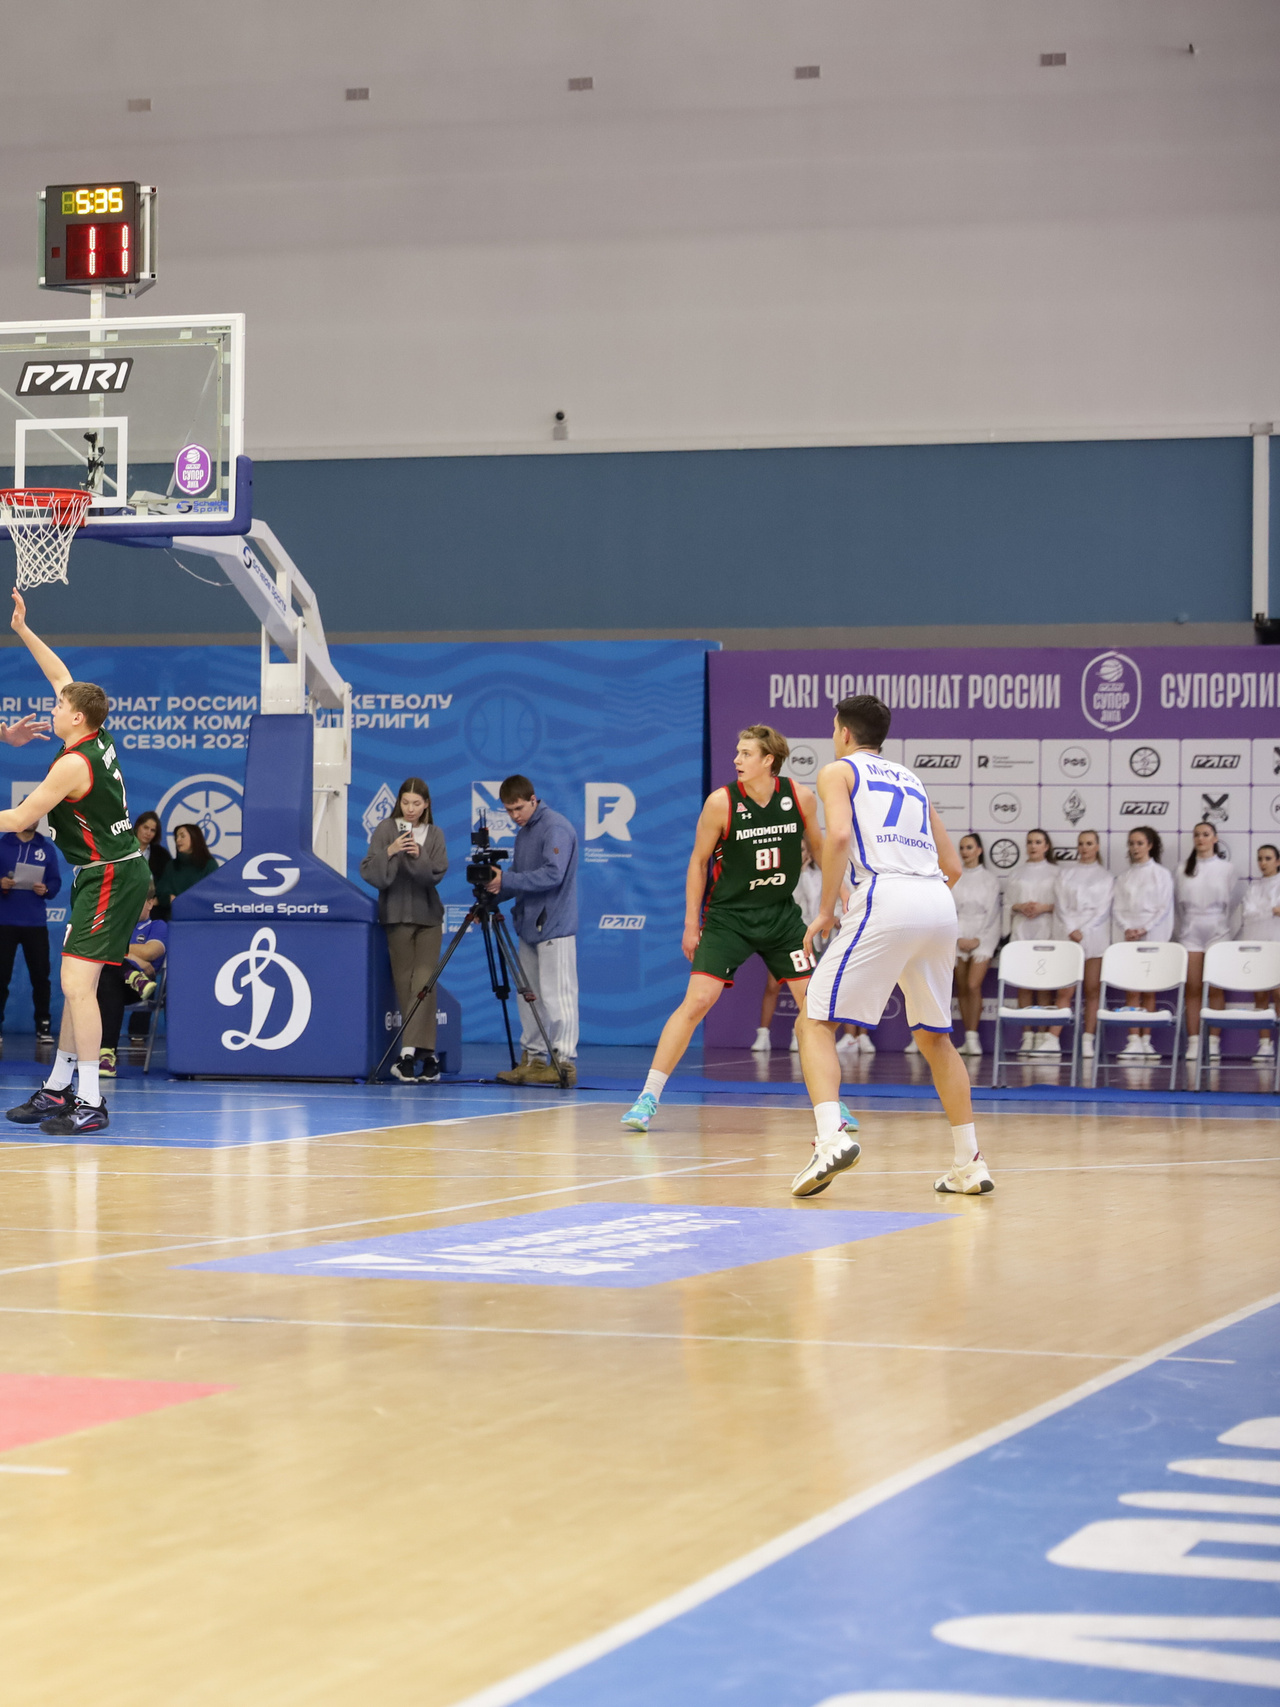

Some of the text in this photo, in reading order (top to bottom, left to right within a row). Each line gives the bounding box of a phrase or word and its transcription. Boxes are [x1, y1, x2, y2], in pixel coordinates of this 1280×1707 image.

[76, 188, 123, 214] 5:35
[88, 225, 129, 275] 11
[20, 361, 128, 392] PARI
[770, 674, 818, 708] PARI
[968, 674, 1061, 709] РОССИИ
[167, 696, 257, 711] РОССИИ
[316, 714, 430, 728] УПЕРЛИГИ
[123, 734, 248, 749] СЕЗОН 202
[916, 756, 960, 767] PARI
[1193, 756, 1239, 768] PARI
[866, 779, 928, 835] 77
[1122, 803, 1167, 814] PARI
[736, 822, 797, 841] ЛОКОМОТИВ
[753, 837, 782, 845] КУБАНЬ
[756, 847, 781, 871] 81
[213, 903, 329, 916] Schelde Sports
[602, 916, 643, 928] PARI
[1034, 958, 1048, 976] 8
[1139, 960, 1153, 978] 7
[1241, 960, 1252, 975] 6
